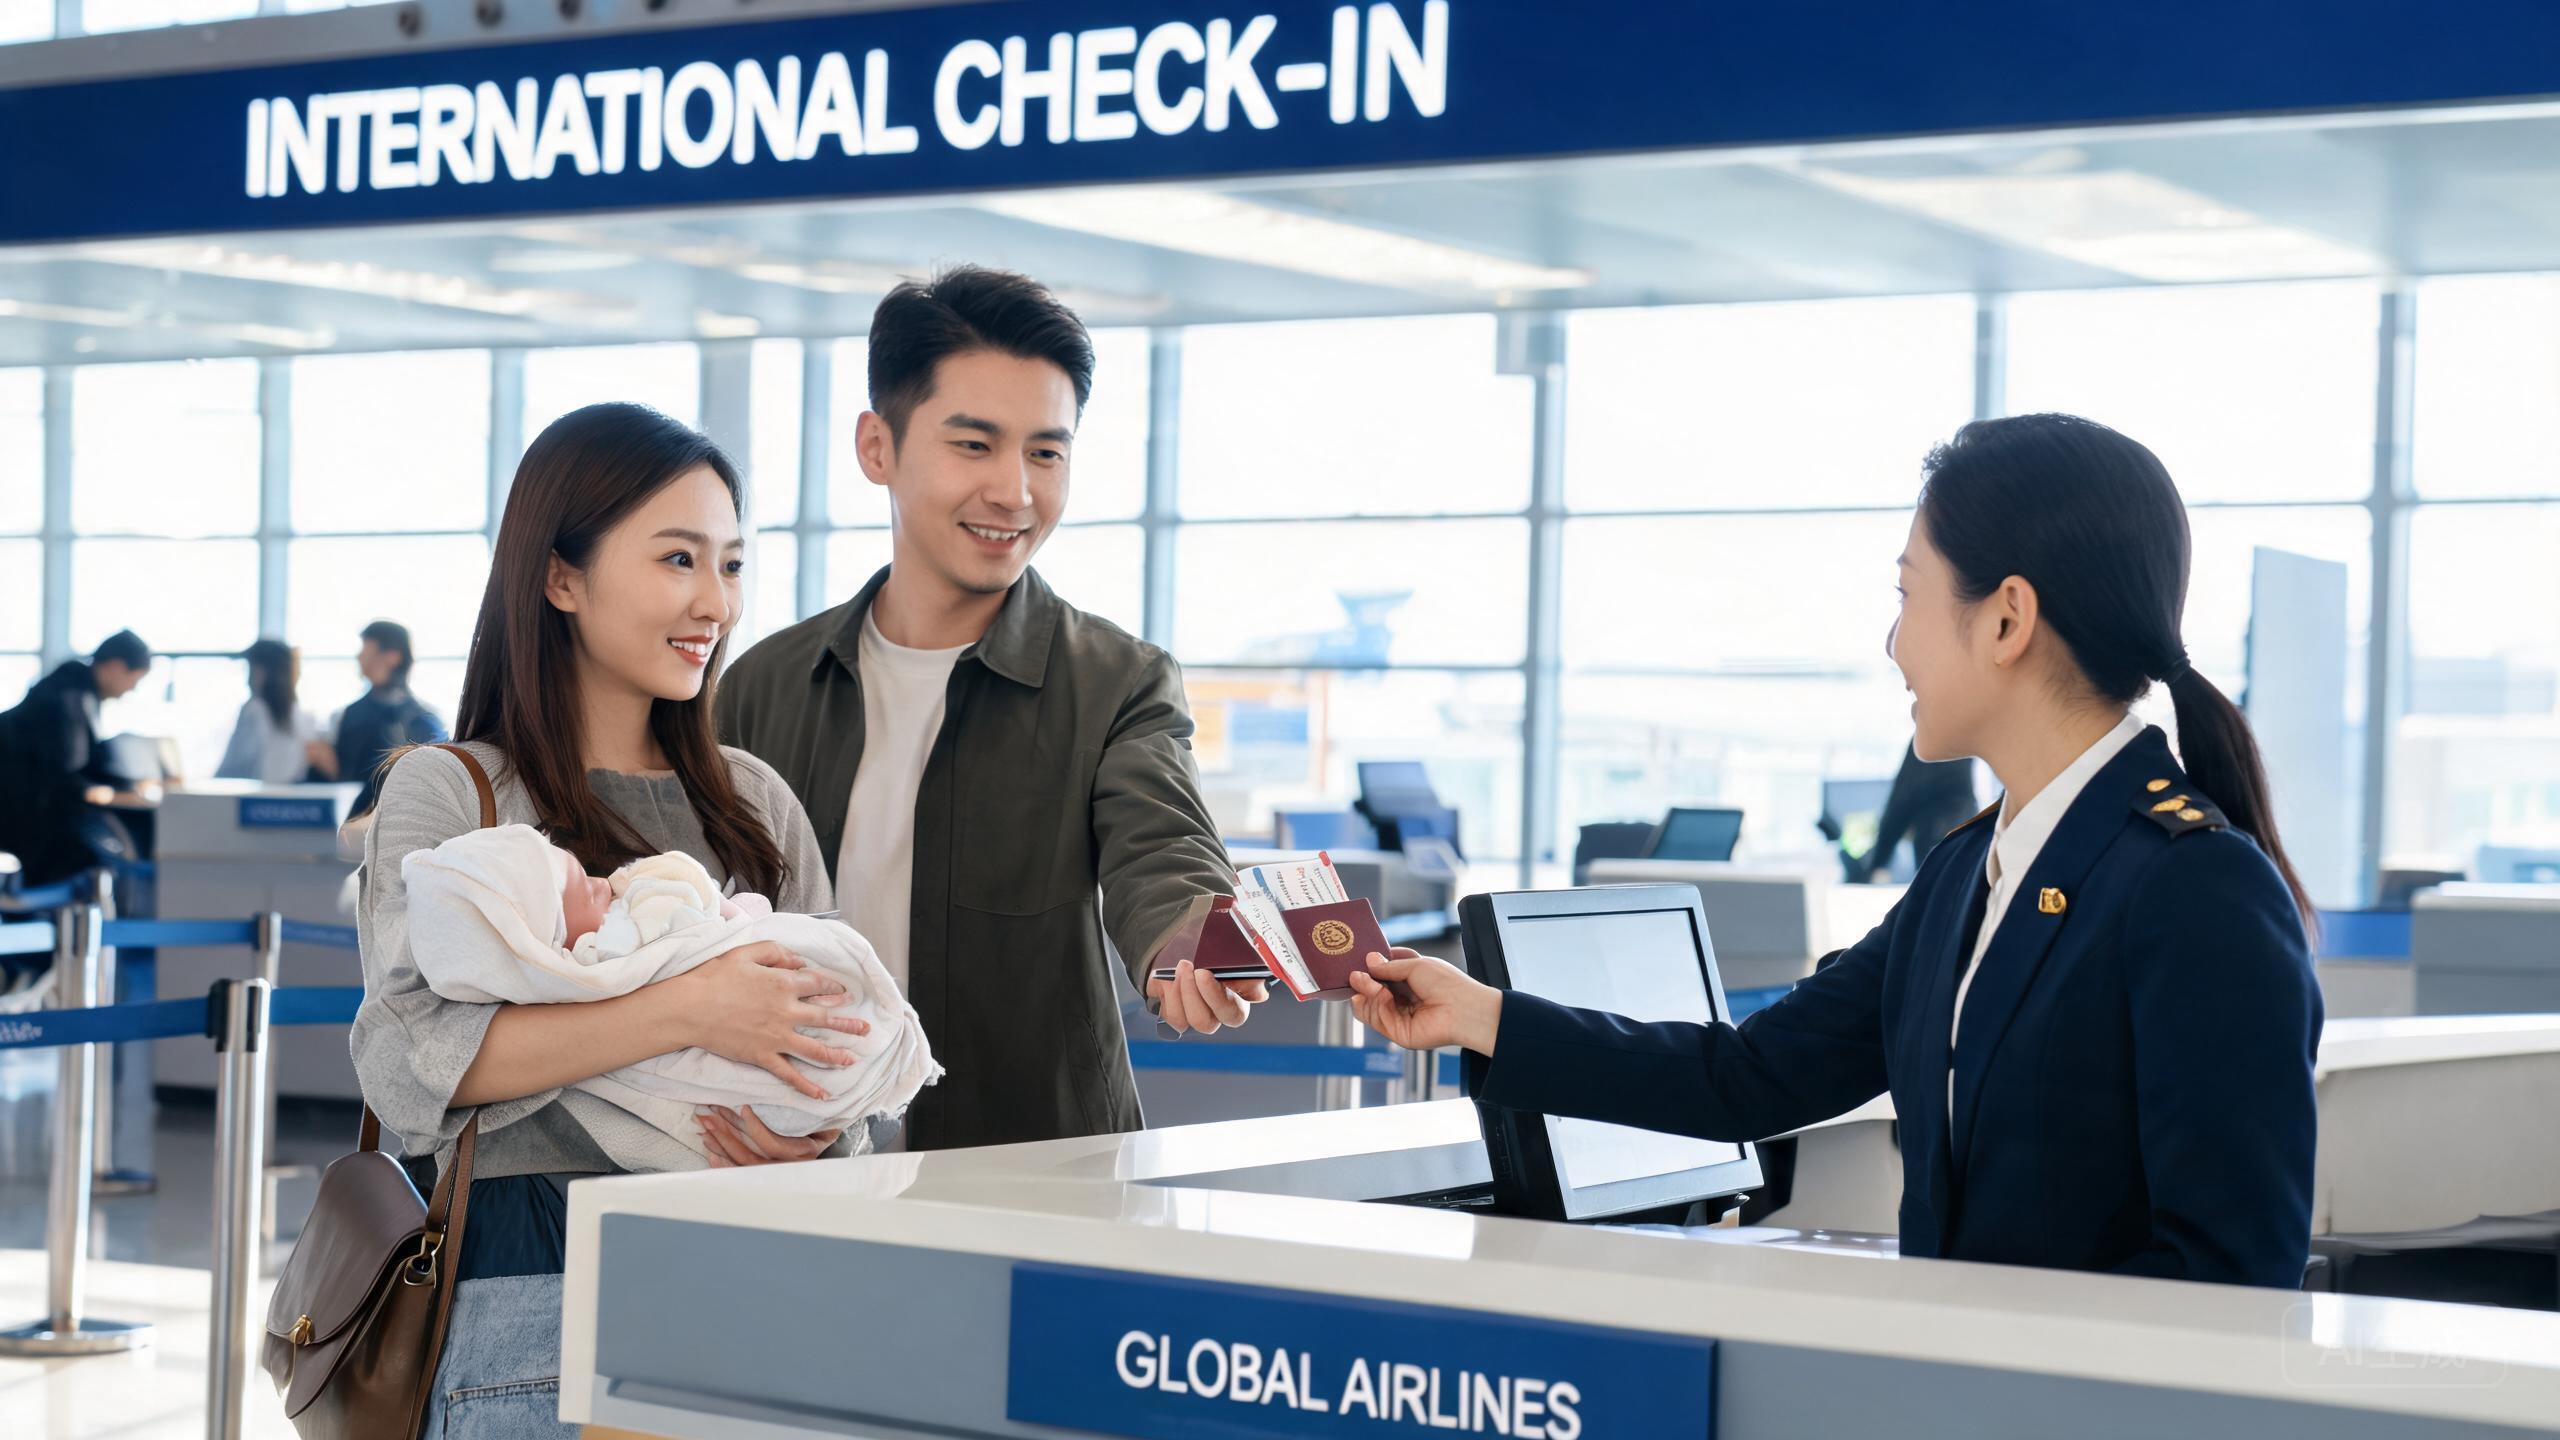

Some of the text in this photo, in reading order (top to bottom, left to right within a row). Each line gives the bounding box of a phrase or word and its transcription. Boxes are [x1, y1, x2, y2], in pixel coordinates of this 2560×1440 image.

[246, 0, 1448, 197] INTERNATIONAL CHECK-IN
[1116, 1330, 1581, 1440] GLOBAL AIRLINES
